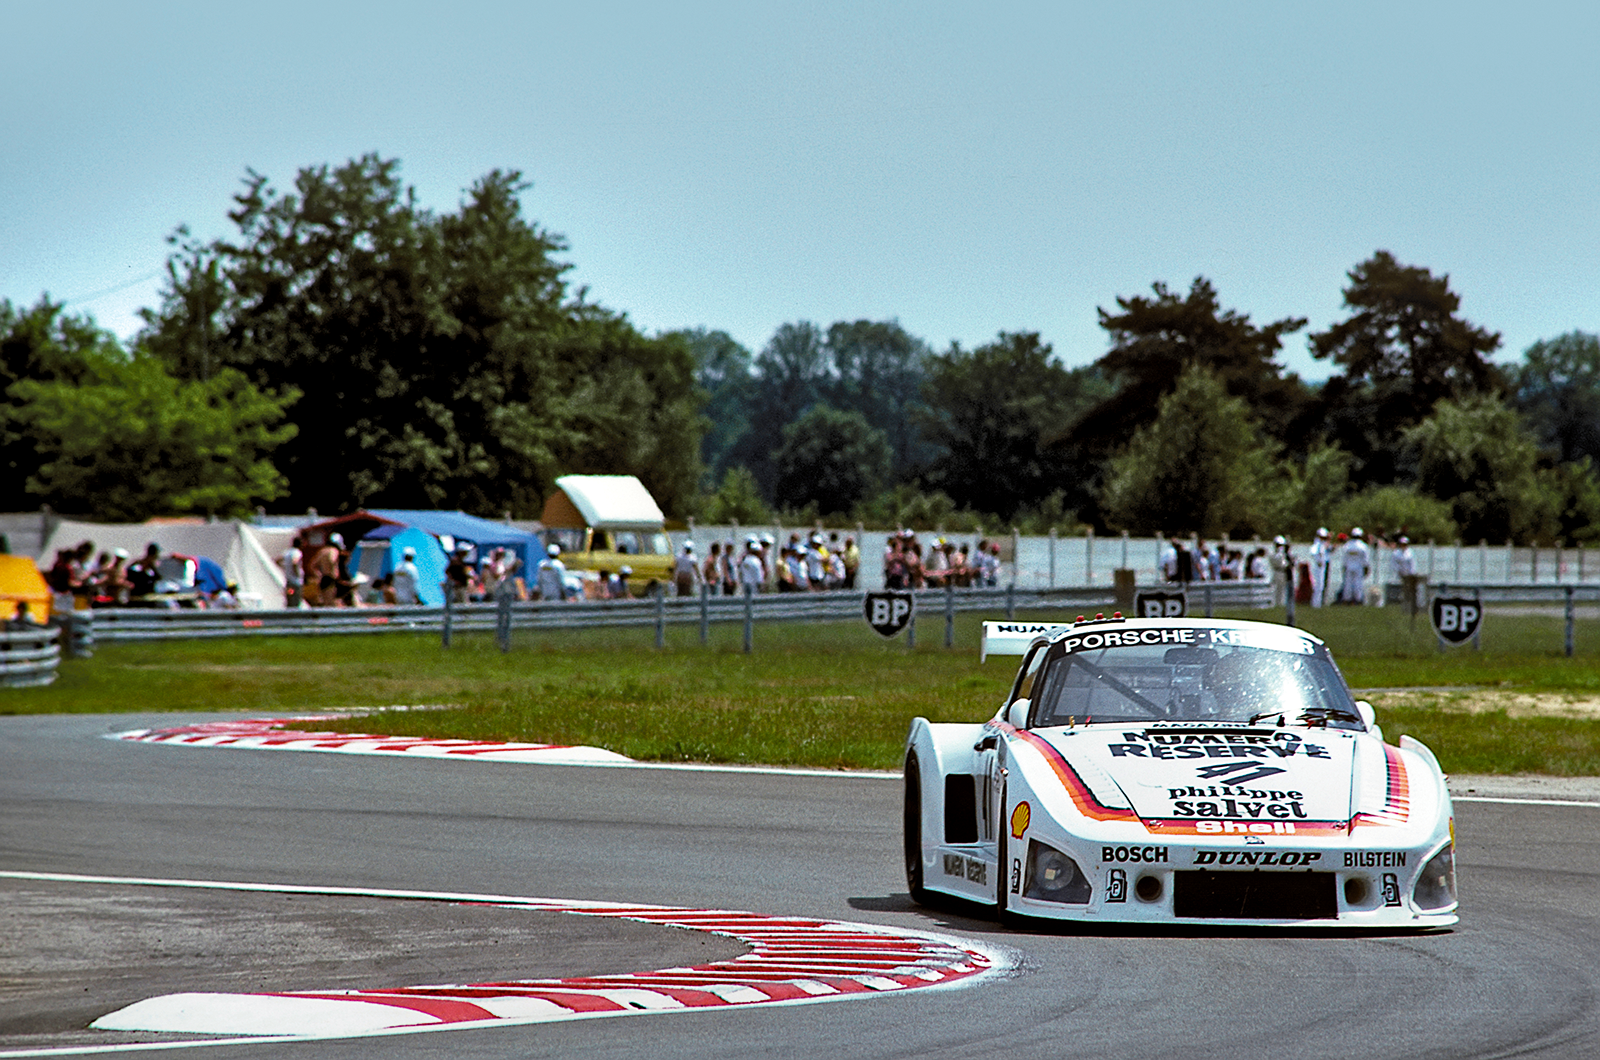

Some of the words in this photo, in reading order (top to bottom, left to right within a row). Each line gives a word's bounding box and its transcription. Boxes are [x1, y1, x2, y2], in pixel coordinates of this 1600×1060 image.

[871, 598, 909, 627] BP
[1143, 599, 1182, 618] BP
[1440, 604, 1478, 632] BP
[1065, 628, 1316, 655] PORSCHE-KRR
[1122, 730, 1302, 745] NUMERO
[1107, 743, 1332, 761] RESERVE
[1167, 785, 1304, 801] philippe
[1172, 798, 1308, 819] salvet
[1195, 820, 1297, 834] Shell
[1102, 846, 1169, 863] BOSCH
[1193, 850, 1322, 866] DUNLOP
[1343, 851, 1407, 868] BILSTEIN
